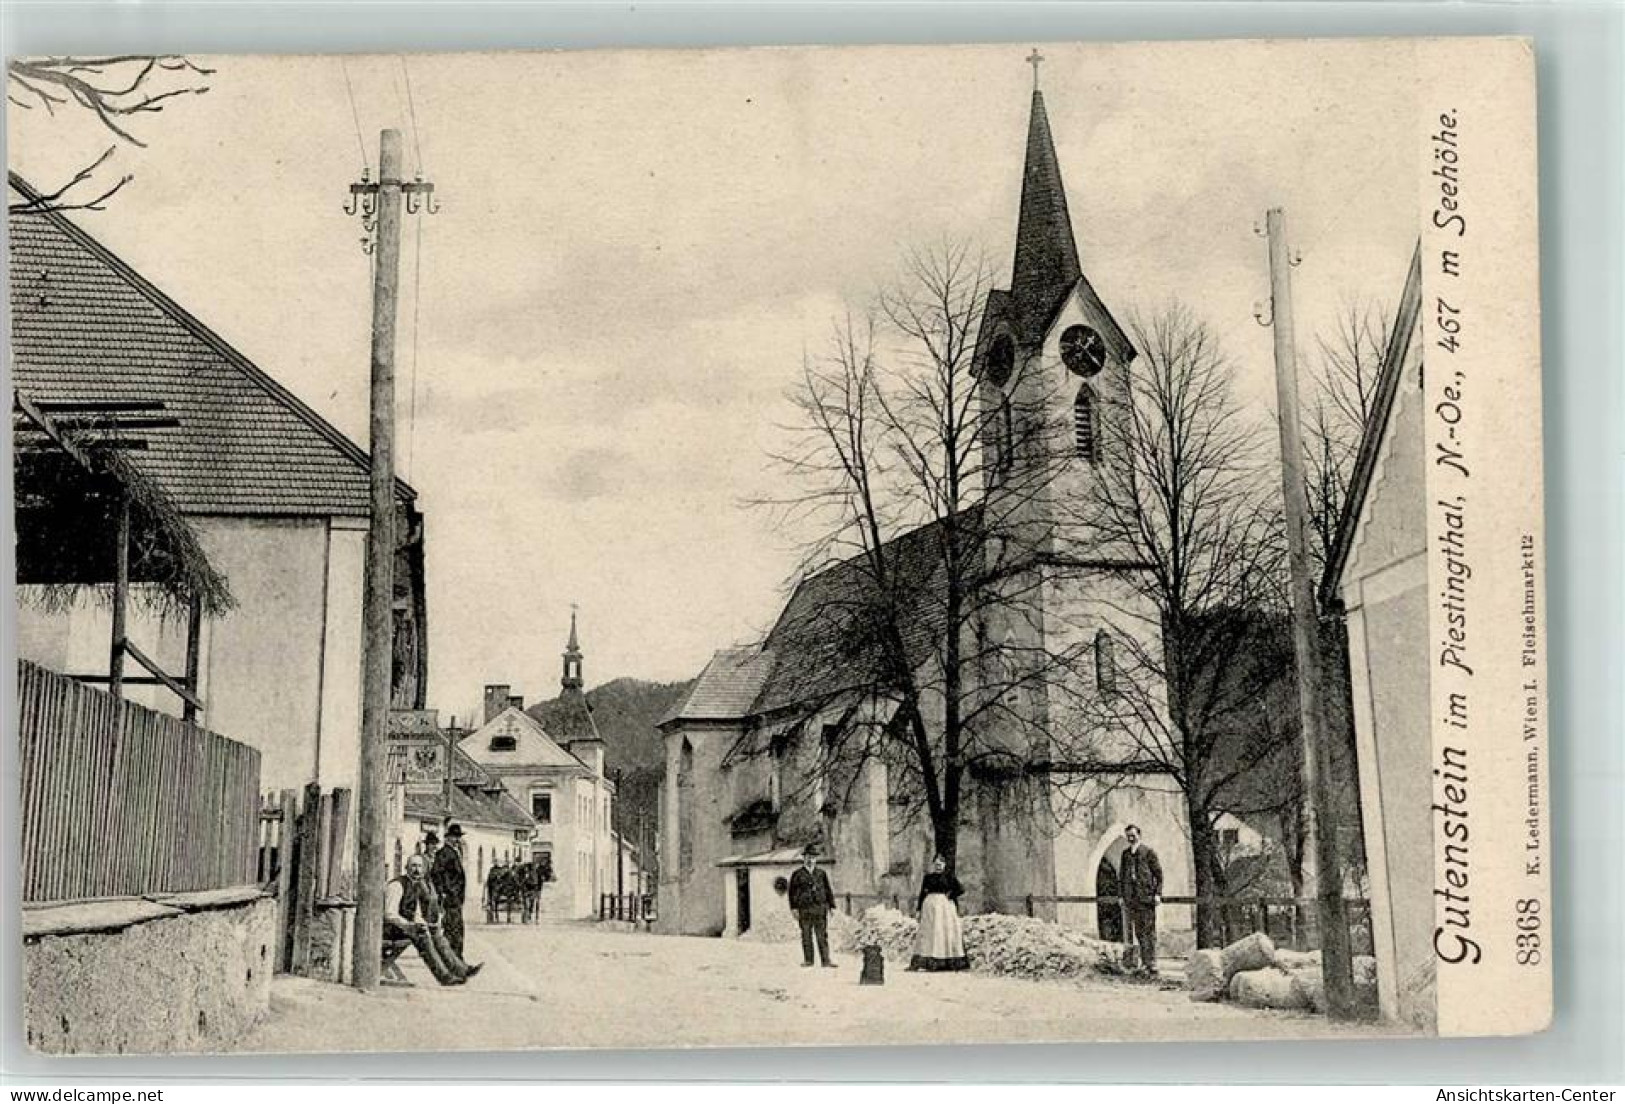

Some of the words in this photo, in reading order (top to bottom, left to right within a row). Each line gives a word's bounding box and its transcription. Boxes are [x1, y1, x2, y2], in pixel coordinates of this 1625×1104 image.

[1432, 108, 1466, 237] Seehöhe.
[1442, 250, 1460, 277] m
[1437, 297, 1461, 354] 467
[1438, 496, 1473, 676] Piestingthal,
[1443, 693, 1467, 729] im
[1523, 696, 1538, 741] Wien
[1524, 746, 1540, 850] Ledermann,
[1432, 746, 1482, 965] Gutenstein
[1526, 856, 1541, 875] K.
[1515, 898, 1541, 966] 8368
